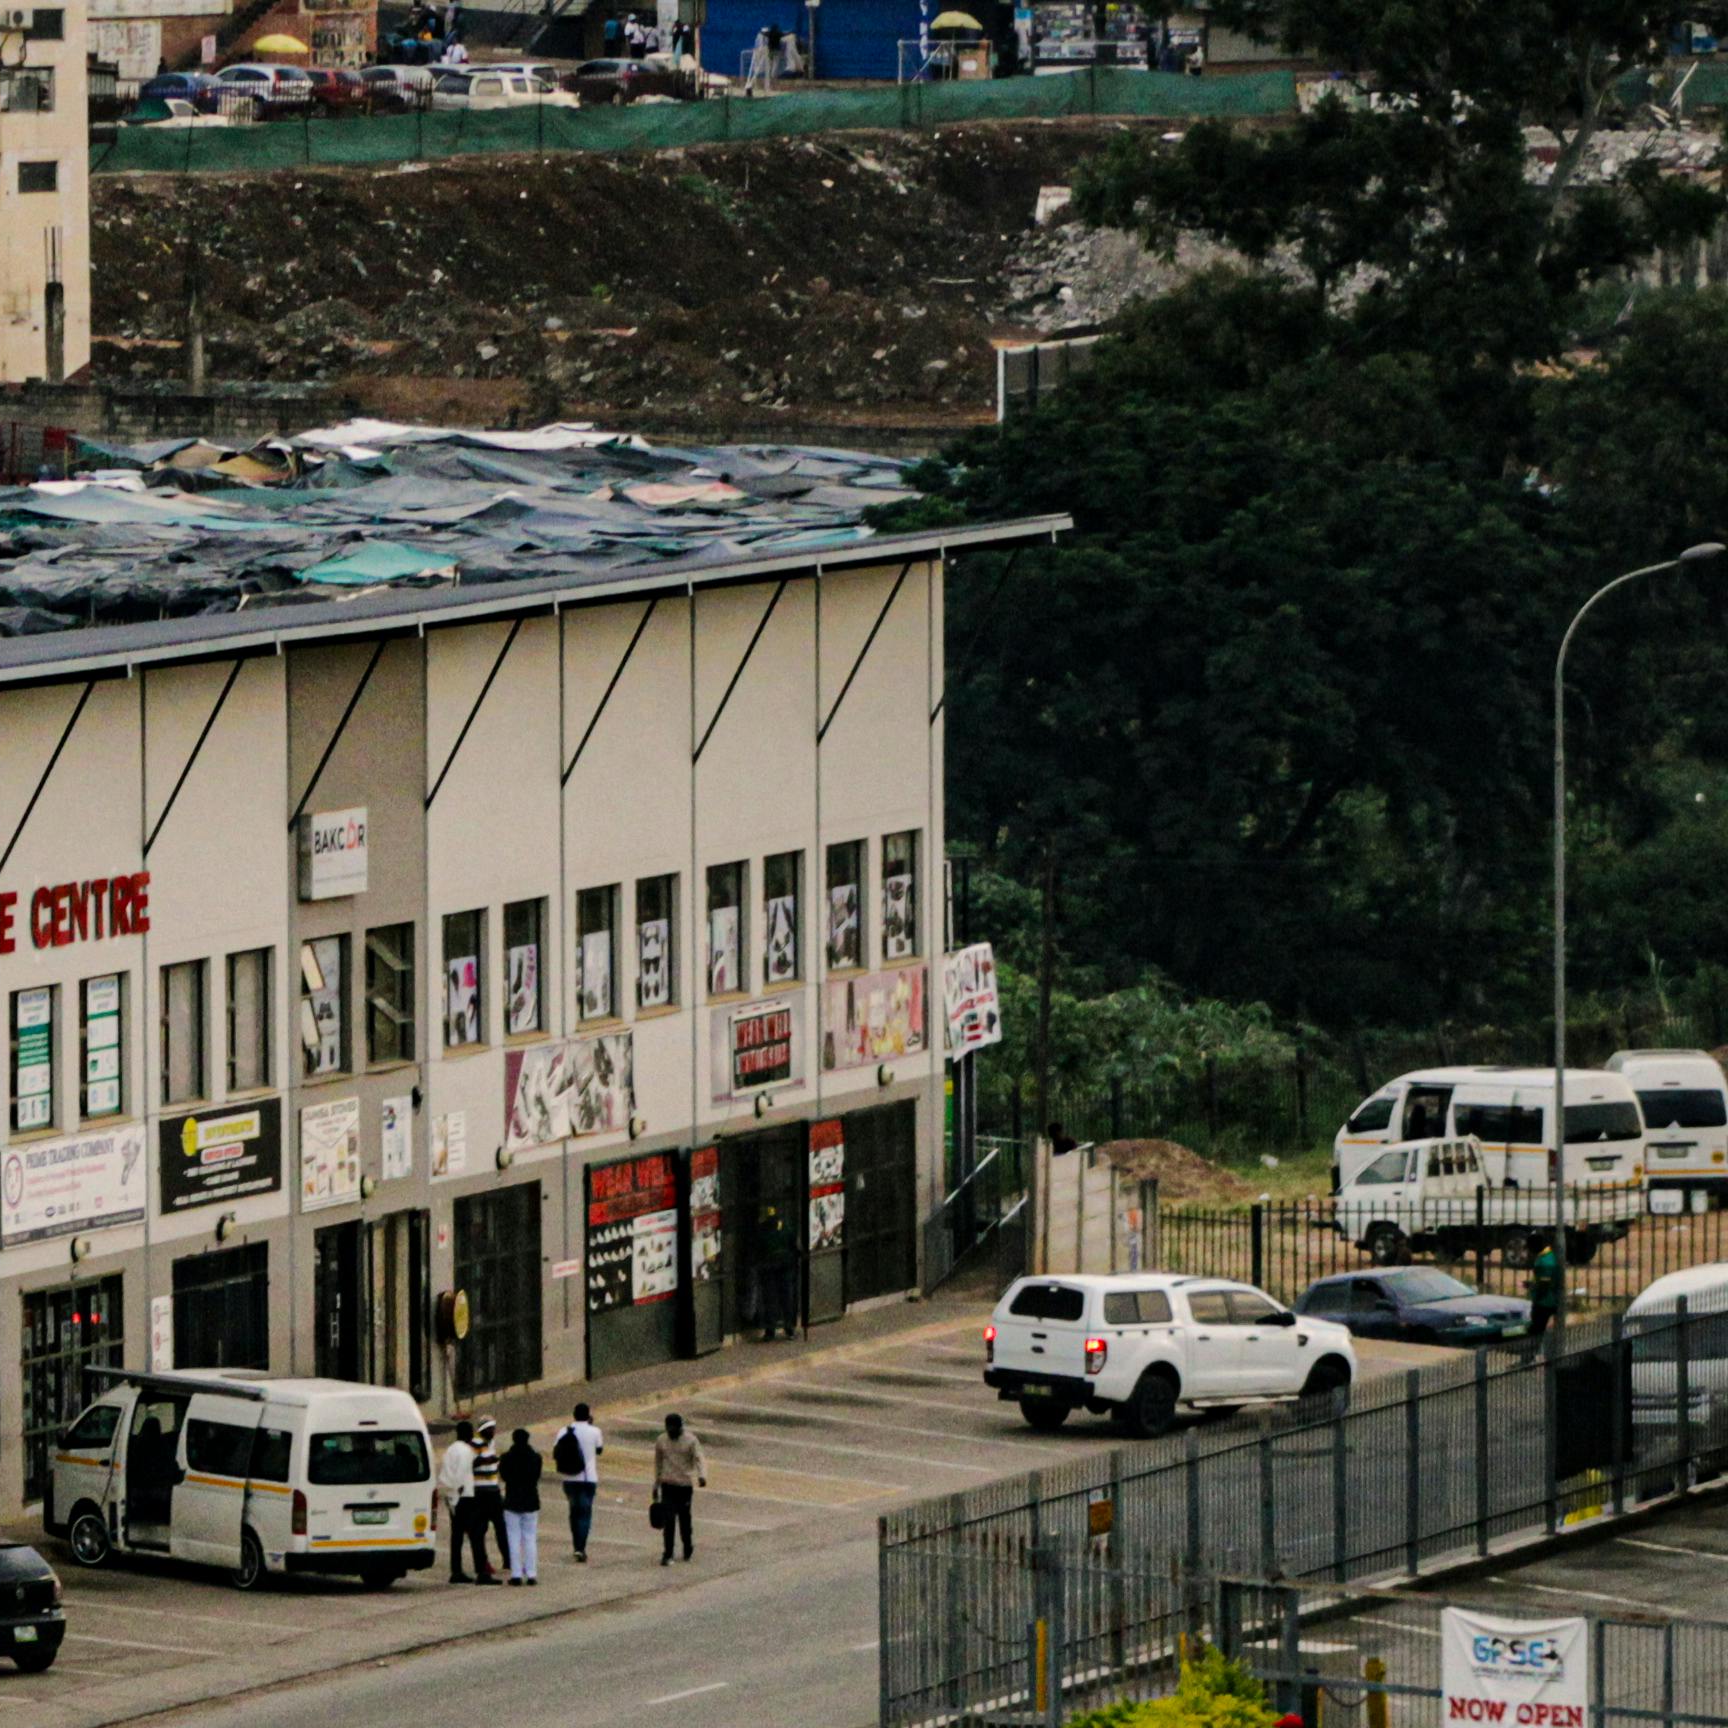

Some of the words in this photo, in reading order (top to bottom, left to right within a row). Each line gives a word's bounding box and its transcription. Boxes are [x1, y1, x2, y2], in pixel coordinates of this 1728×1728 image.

[30, 870, 150, 950] CENTRE
[1448, 1695, 1507, 1722] NOW
[1516, 1703, 1584, 1728] OPEN
